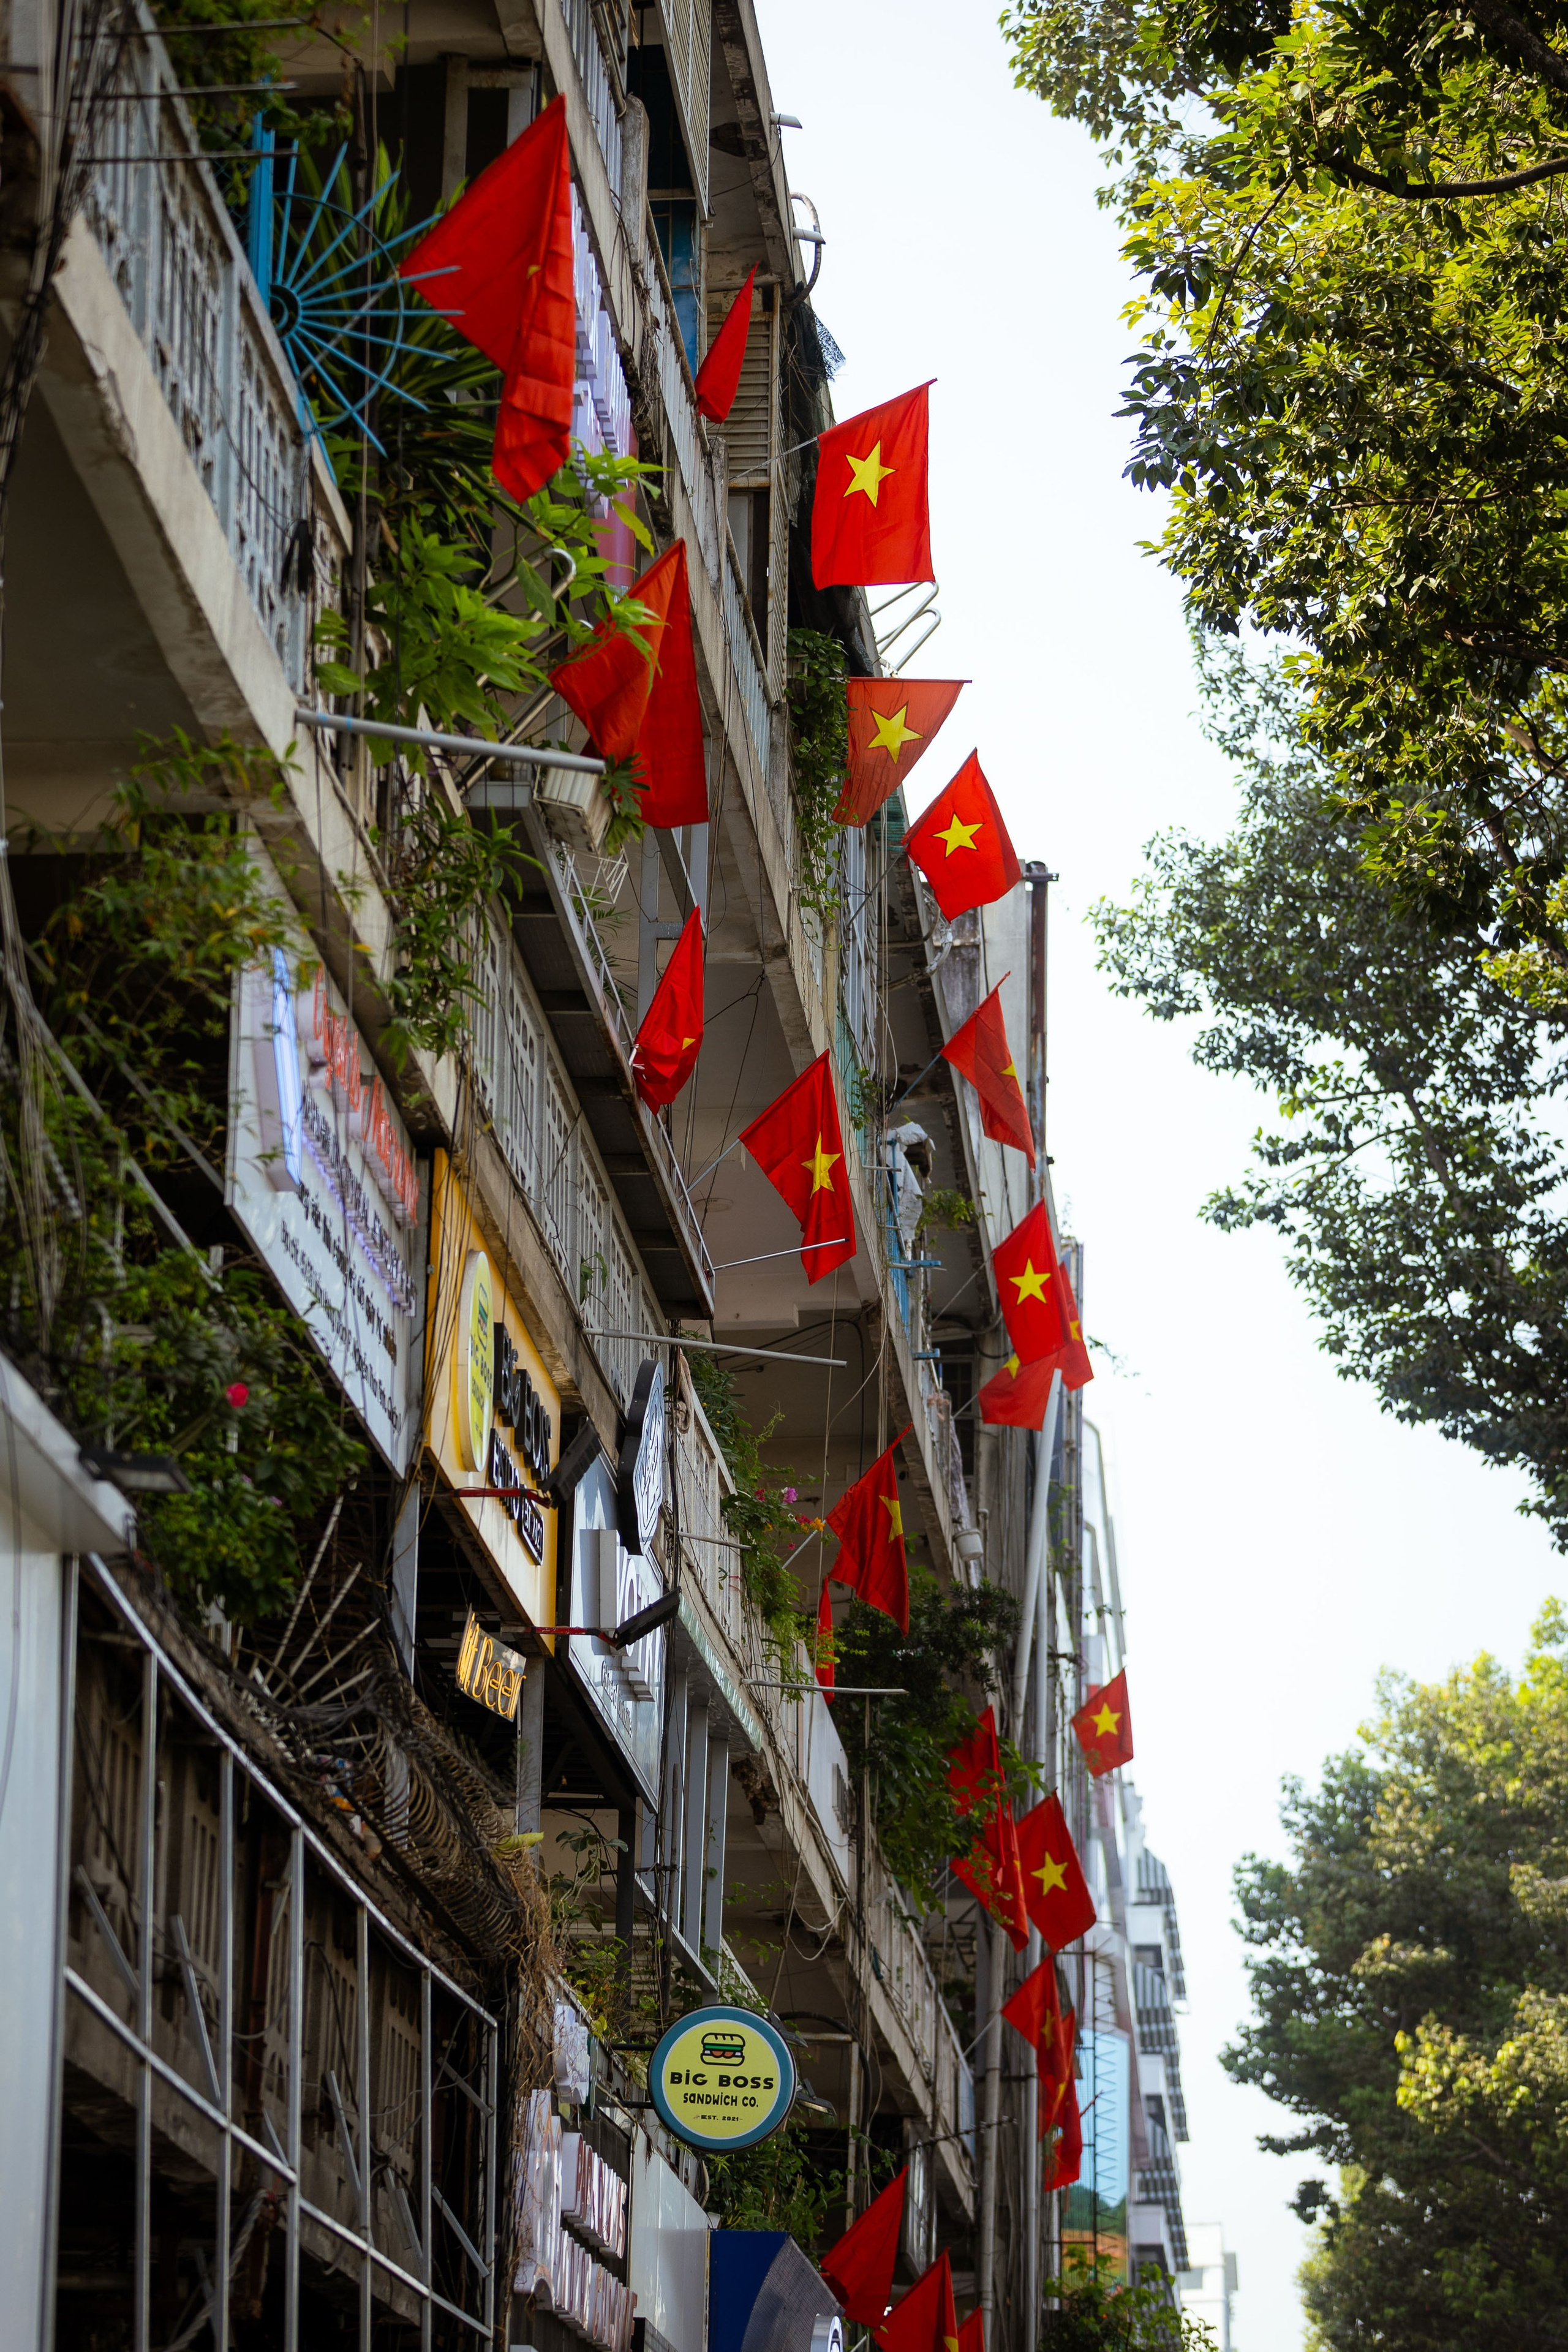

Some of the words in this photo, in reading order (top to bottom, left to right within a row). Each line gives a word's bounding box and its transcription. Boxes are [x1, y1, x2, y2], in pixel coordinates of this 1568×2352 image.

[522, 1369, 552, 1481] BOSS
[472, 1637, 527, 1719] Beer
[718, 2074, 774, 2090] BOSS
[742, 2096, 759, 2108] CO.
